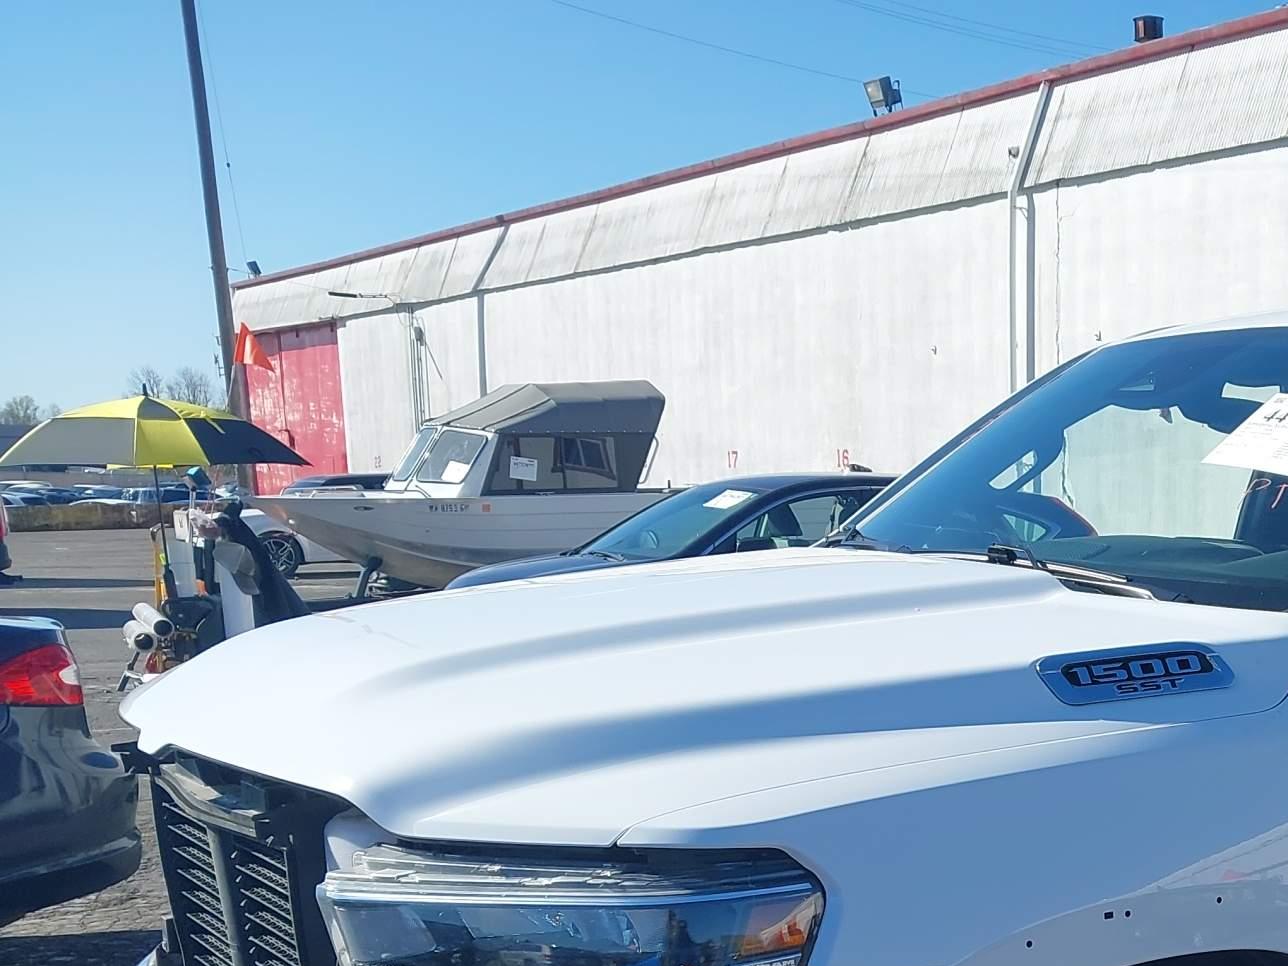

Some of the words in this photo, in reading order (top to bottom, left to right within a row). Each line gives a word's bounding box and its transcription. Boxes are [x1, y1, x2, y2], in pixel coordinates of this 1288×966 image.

[727, 450, 739, 469] 17
[836, 448, 850, 468] 16
[1070, 654, 1202, 686] 1500
[1114, 677, 1186, 697] SST
